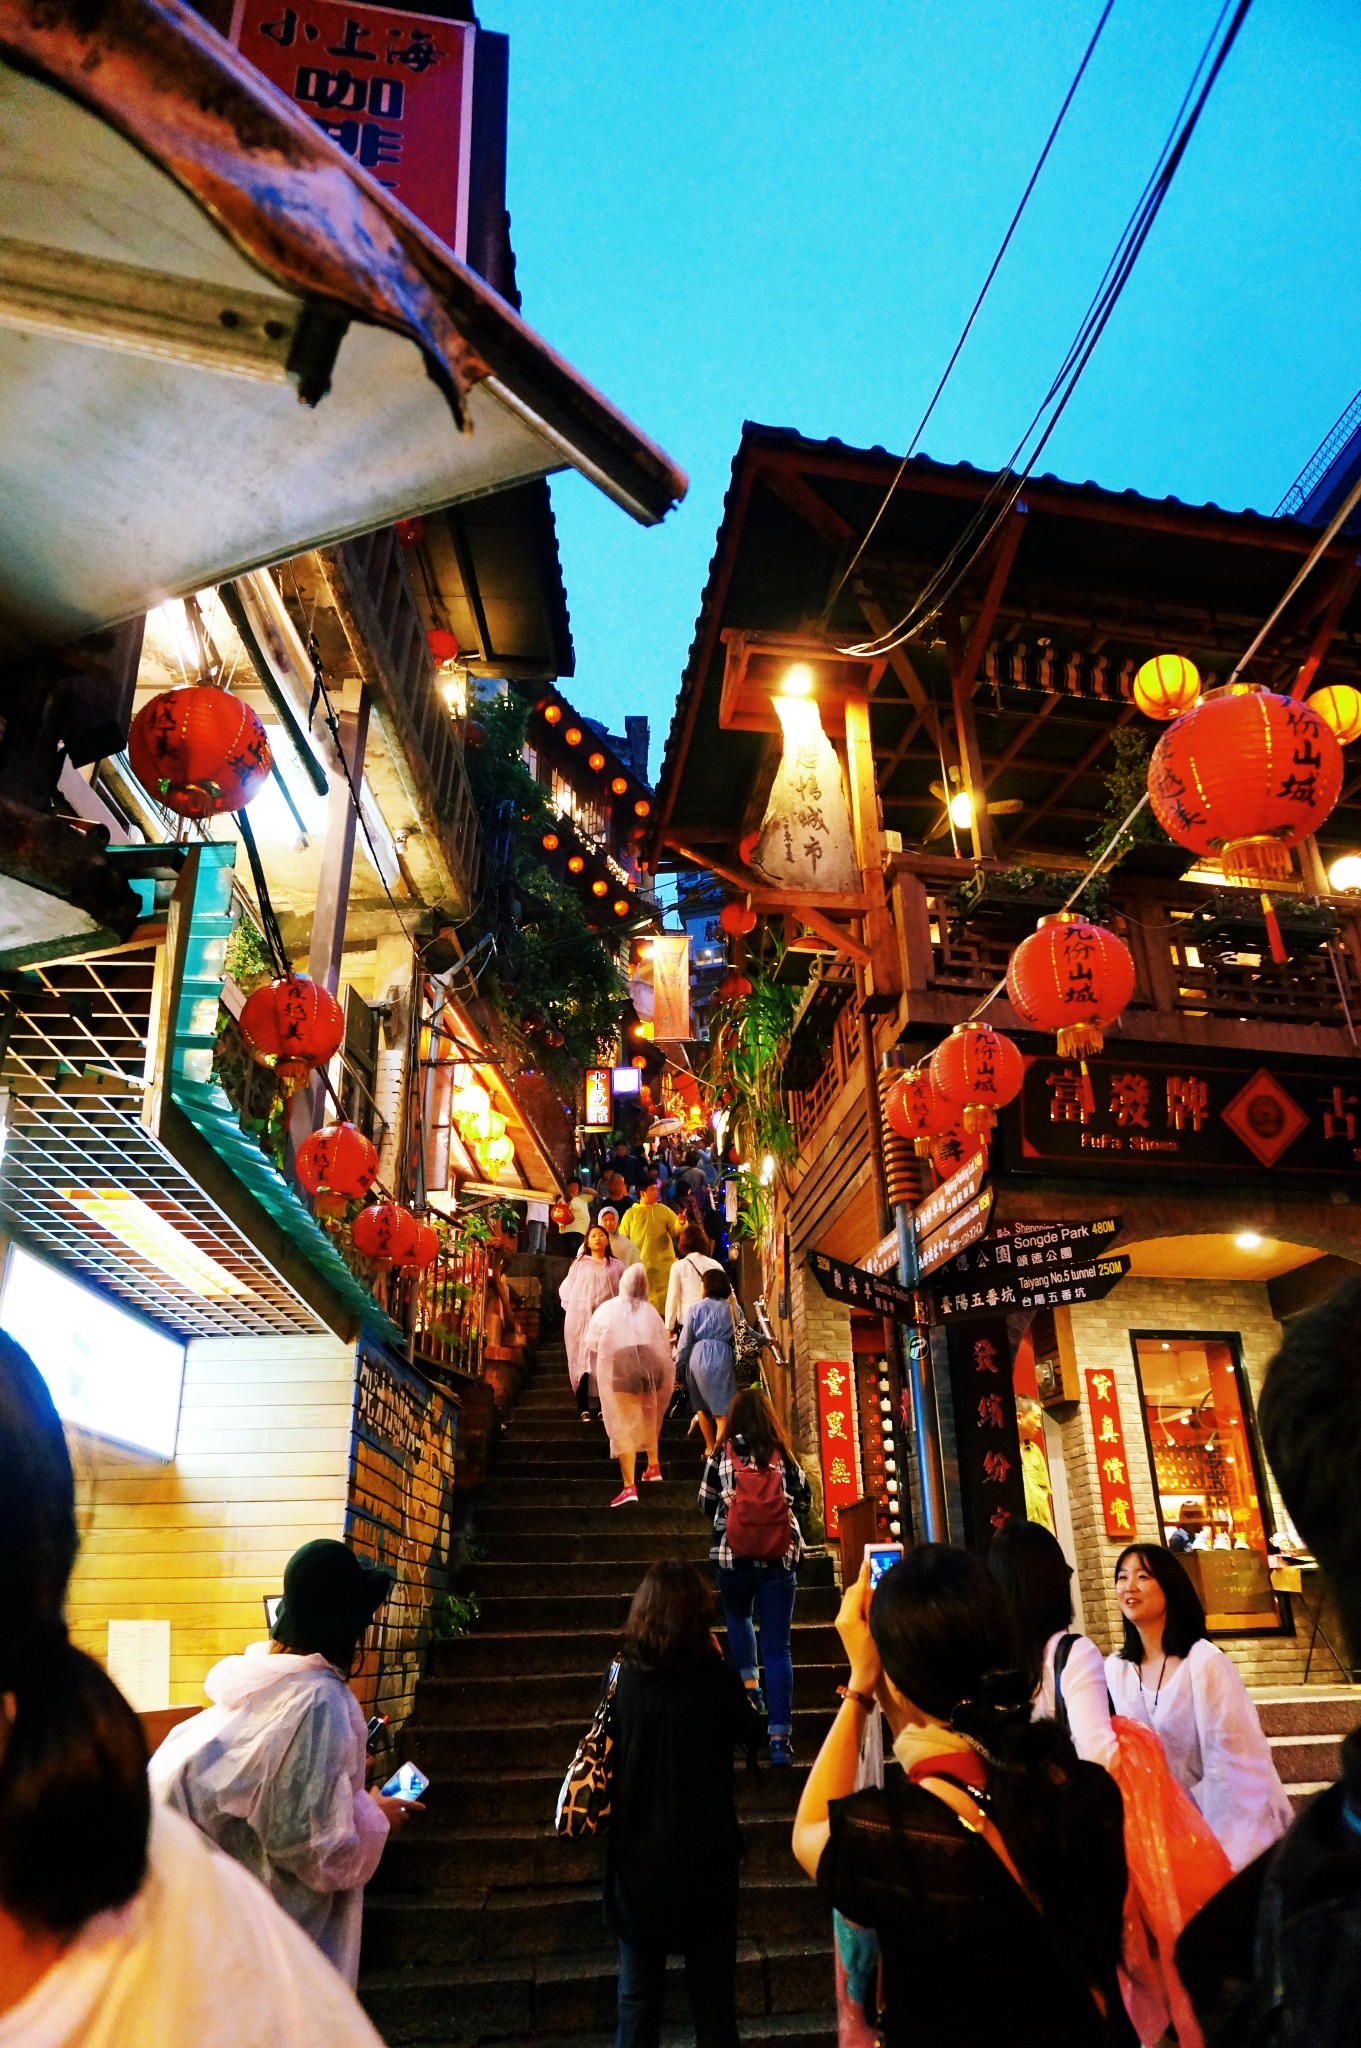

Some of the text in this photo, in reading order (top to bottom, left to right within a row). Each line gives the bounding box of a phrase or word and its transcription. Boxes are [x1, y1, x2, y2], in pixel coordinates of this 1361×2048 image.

[259, 7, 449, 73] 小上海
[1062, 926, 1098, 1004] 九份山城
[973, 1033, 997, 1093] 九份山城
[1046, 1069, 1208, 1131] 富發牌
[1014, 1231, 1058, 1249] Songde
[1061, 1226, 1090, 1240] Park
[1091, 1220, 1116, 1235] 480M
[1018, 1261, 1122, 1290] Taiyang No.5 tunnel 250M
[1021, 1286, 1087, 1307] 台陽五番坑
[940, 1285, 1016, 1314] 臺陽五番坑
